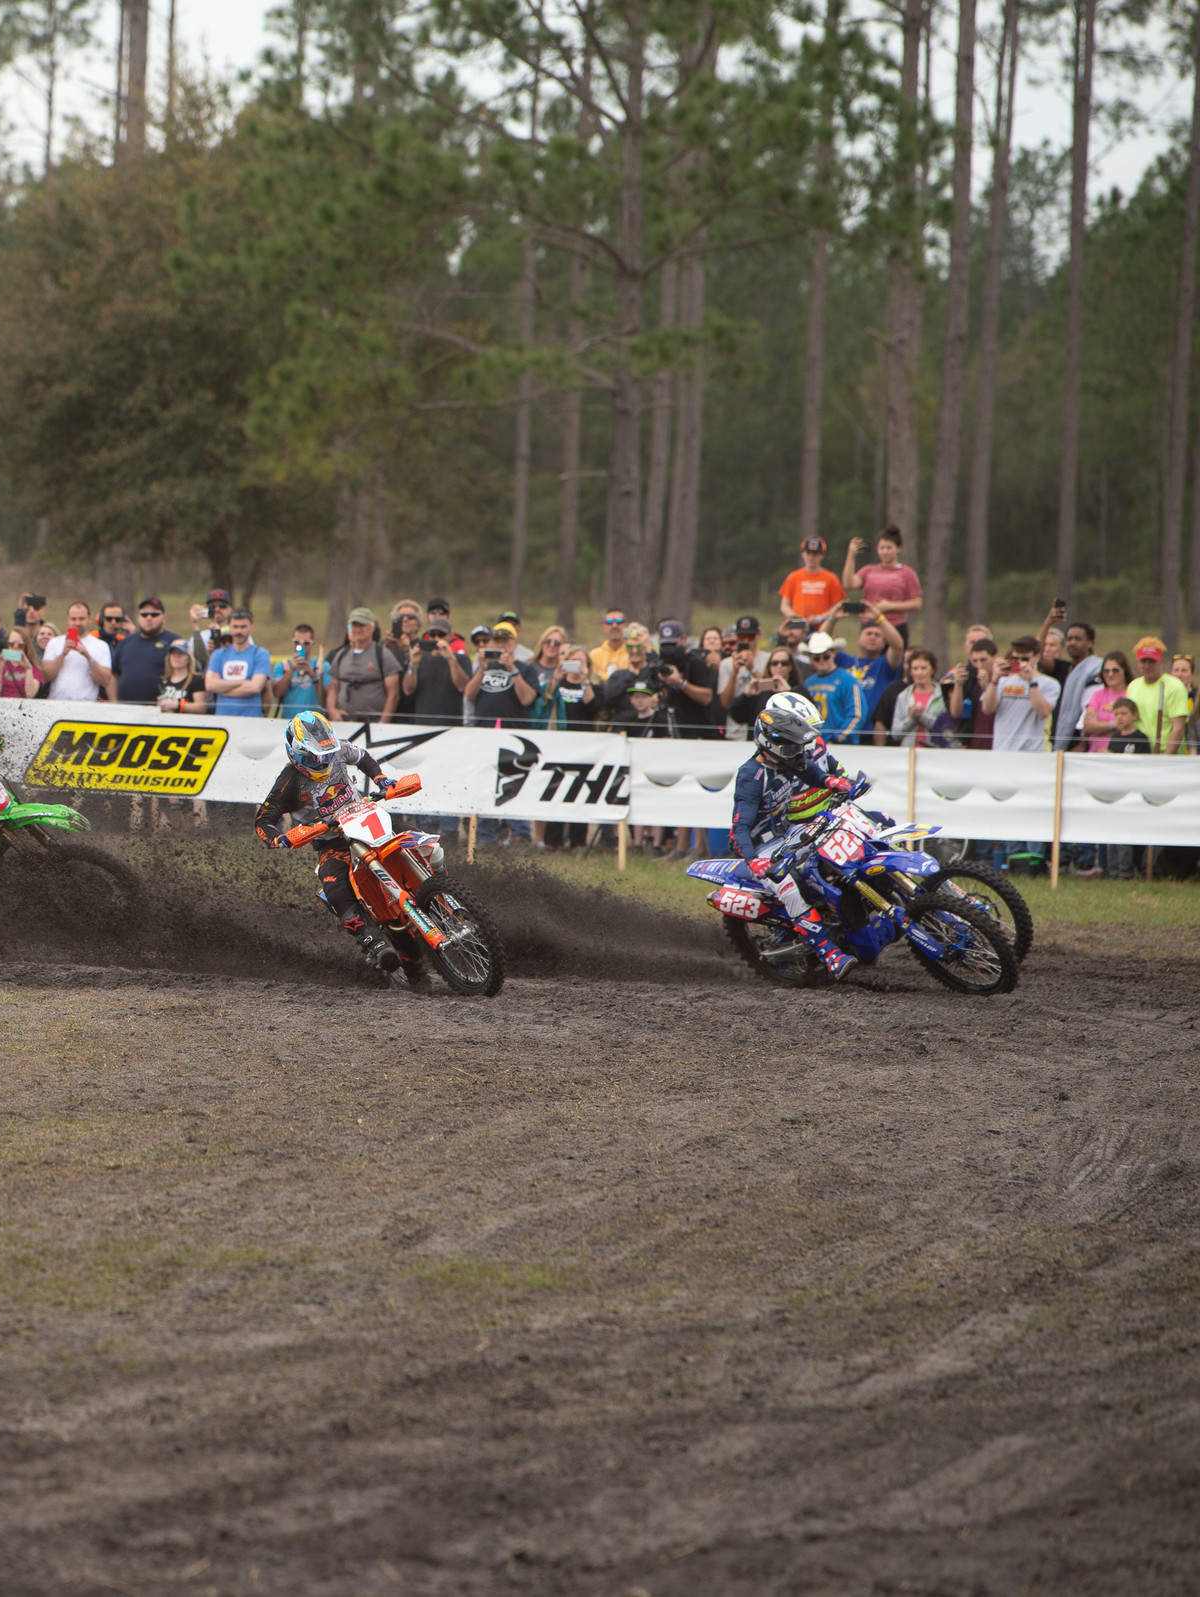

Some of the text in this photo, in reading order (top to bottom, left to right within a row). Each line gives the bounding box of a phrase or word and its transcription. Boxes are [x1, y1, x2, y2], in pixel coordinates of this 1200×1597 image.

[42, 730, 215, 771] MOOSE
[111, 774, 198, 788] DIVISION
[318, 798, 340, 817] Red
[337, 785, 353, 805] Bull
[361, 812, 386, 840] 1
[719, 891, 761, 919] 523
